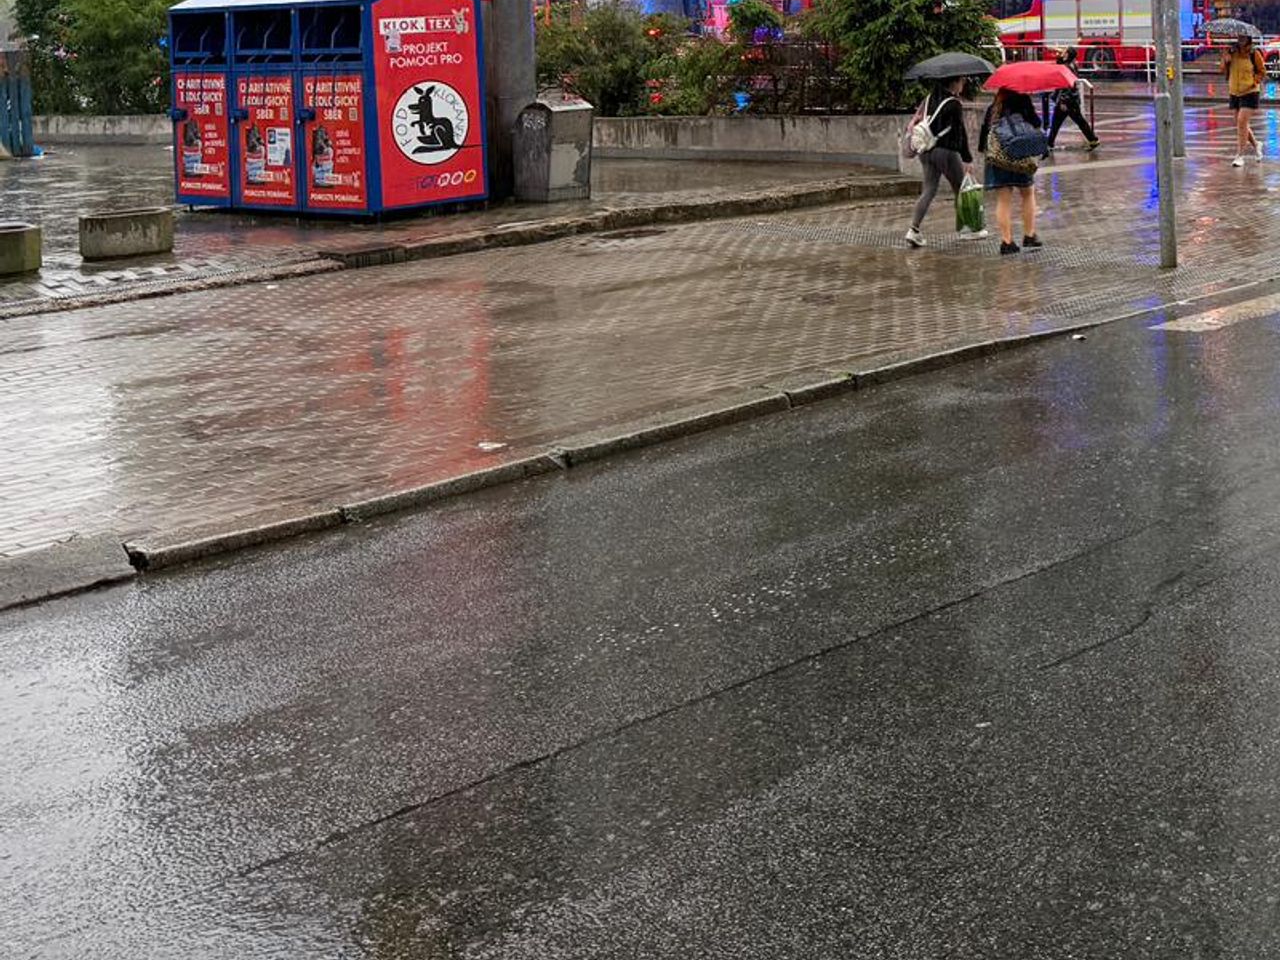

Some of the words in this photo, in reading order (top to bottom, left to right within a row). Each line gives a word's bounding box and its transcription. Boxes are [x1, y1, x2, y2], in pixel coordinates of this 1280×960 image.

[428, 18, 451, 30] TEX
[402, 41, 448, 55] PROJEKT
[389, 54, 438, 68] POMOCI
[440, 53, 463, 64] PRO
[396, 107, 412, 146] FOD
